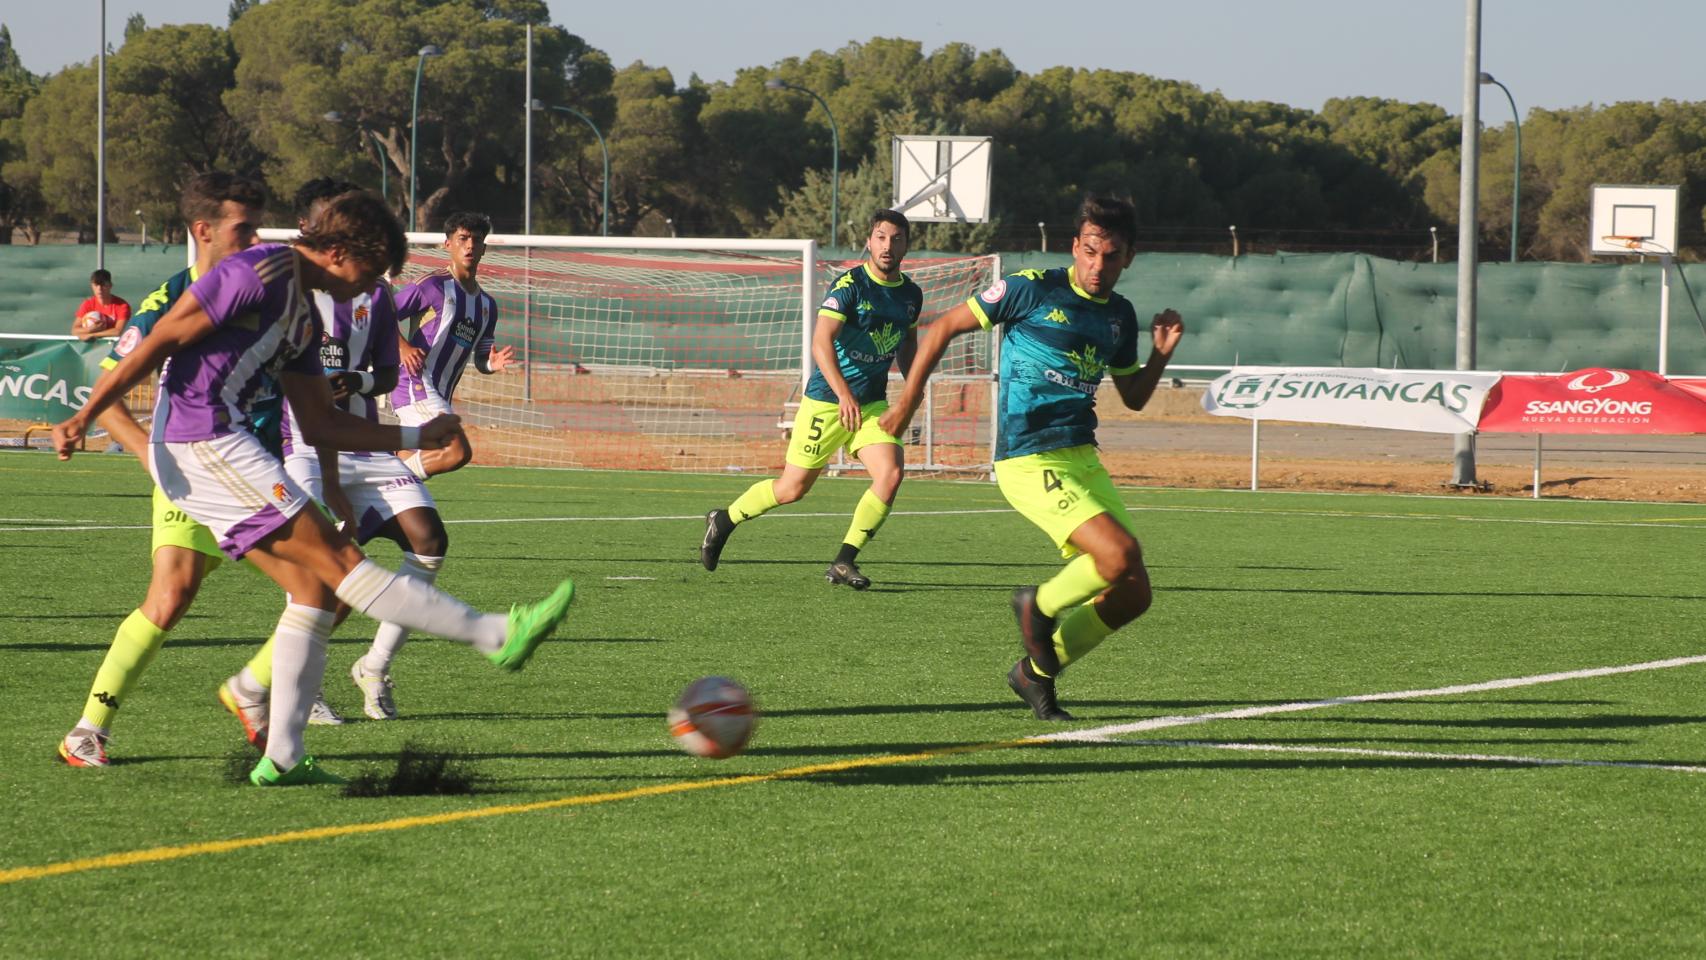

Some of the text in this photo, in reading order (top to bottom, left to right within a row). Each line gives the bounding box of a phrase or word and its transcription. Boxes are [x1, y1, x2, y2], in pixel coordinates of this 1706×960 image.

[320, 345, 344, 356] rella
[0, 373, 93, 411] NCAS
[1277, 380, 1472, 414] SIMANCAS
[1524, 397, 1653, 415] SSANGYONG
[808, 416, 825, 441] 5
[1521, 415, 1650, 424] NUEVA GENERACIÓN
[803, 443, 821, 456] oil
[1043, 469, 1063, 493] 4
[1057, 490, 1080, 510] oil
